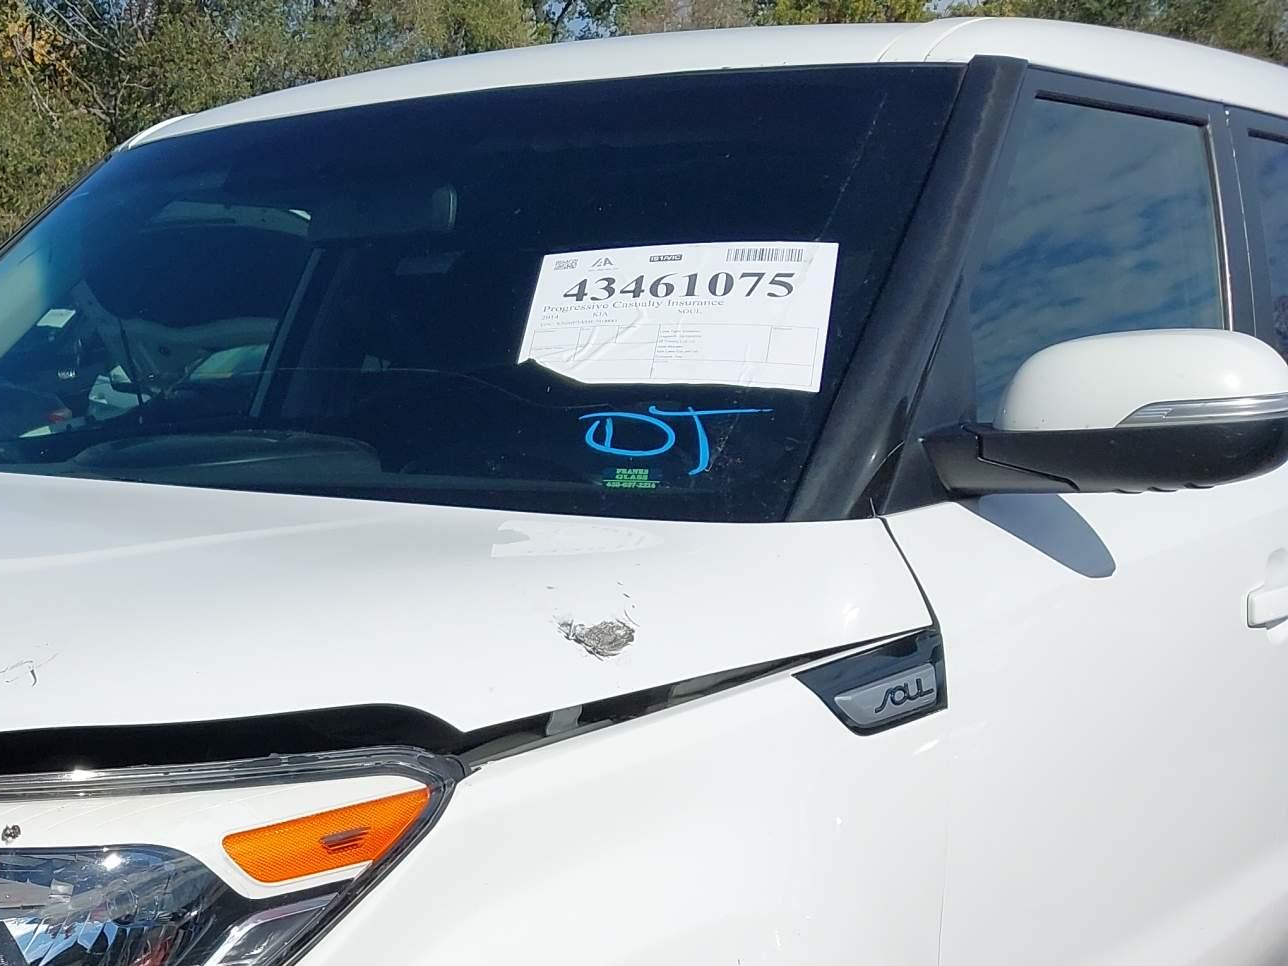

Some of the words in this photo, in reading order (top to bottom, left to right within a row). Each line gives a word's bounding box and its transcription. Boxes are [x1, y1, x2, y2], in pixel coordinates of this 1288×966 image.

[562, 271, 796, 302] 43461075
[543, 303, 609, 313] Progressive
[612, 299, 663, 309] Casualty
[667, 299, 725, 307] Insurance
[874, 678, 935, 714] SOUL
